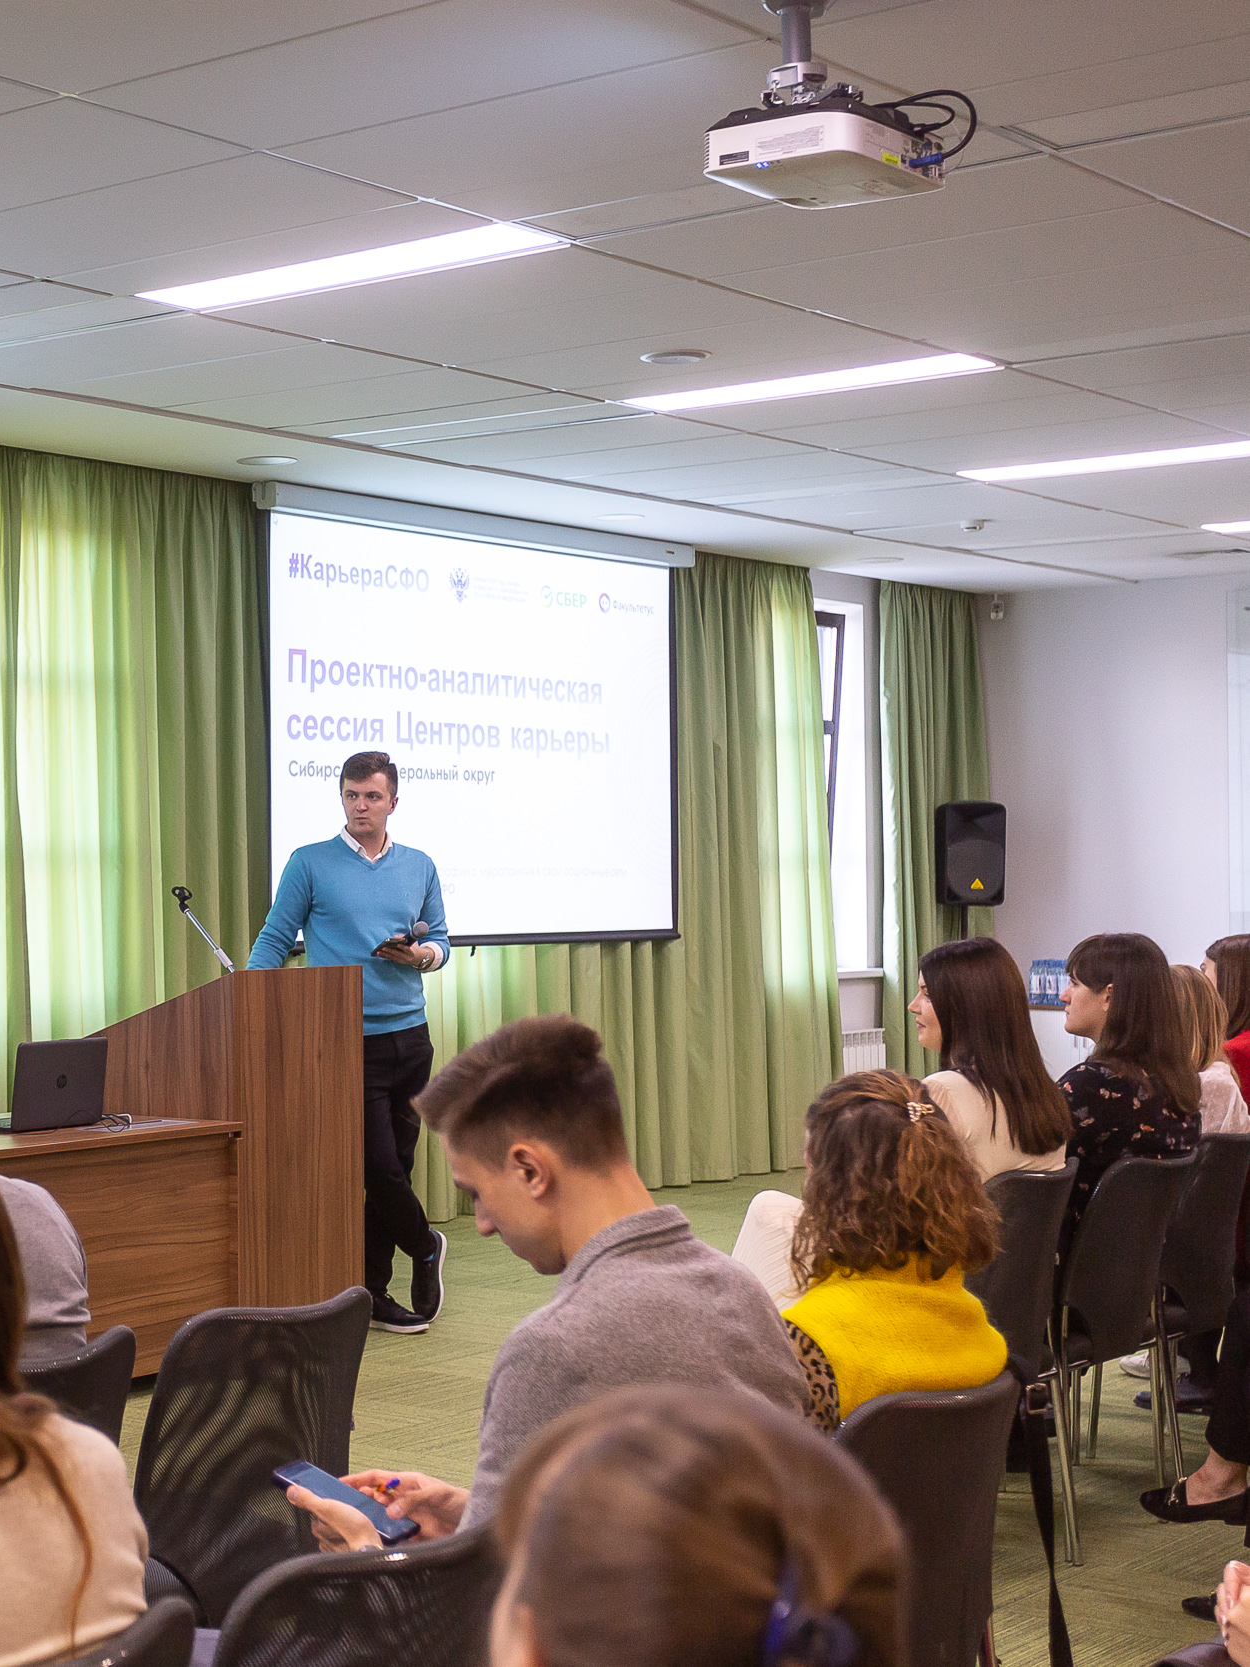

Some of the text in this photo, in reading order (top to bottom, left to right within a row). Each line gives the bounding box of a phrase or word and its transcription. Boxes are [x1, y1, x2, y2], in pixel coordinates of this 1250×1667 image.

[288, 552, 430, 592] #КарьераСФО
[555, 590, 588, 609] СБЕР
[612, 599, 654, 617] Факультетус
[287, 647, 603, 706] Проектно-аналитическая
[286, 710, 610, 761] сессия Центров карьеры
[287, 759, 496, 786] Сибирс еральный округ
